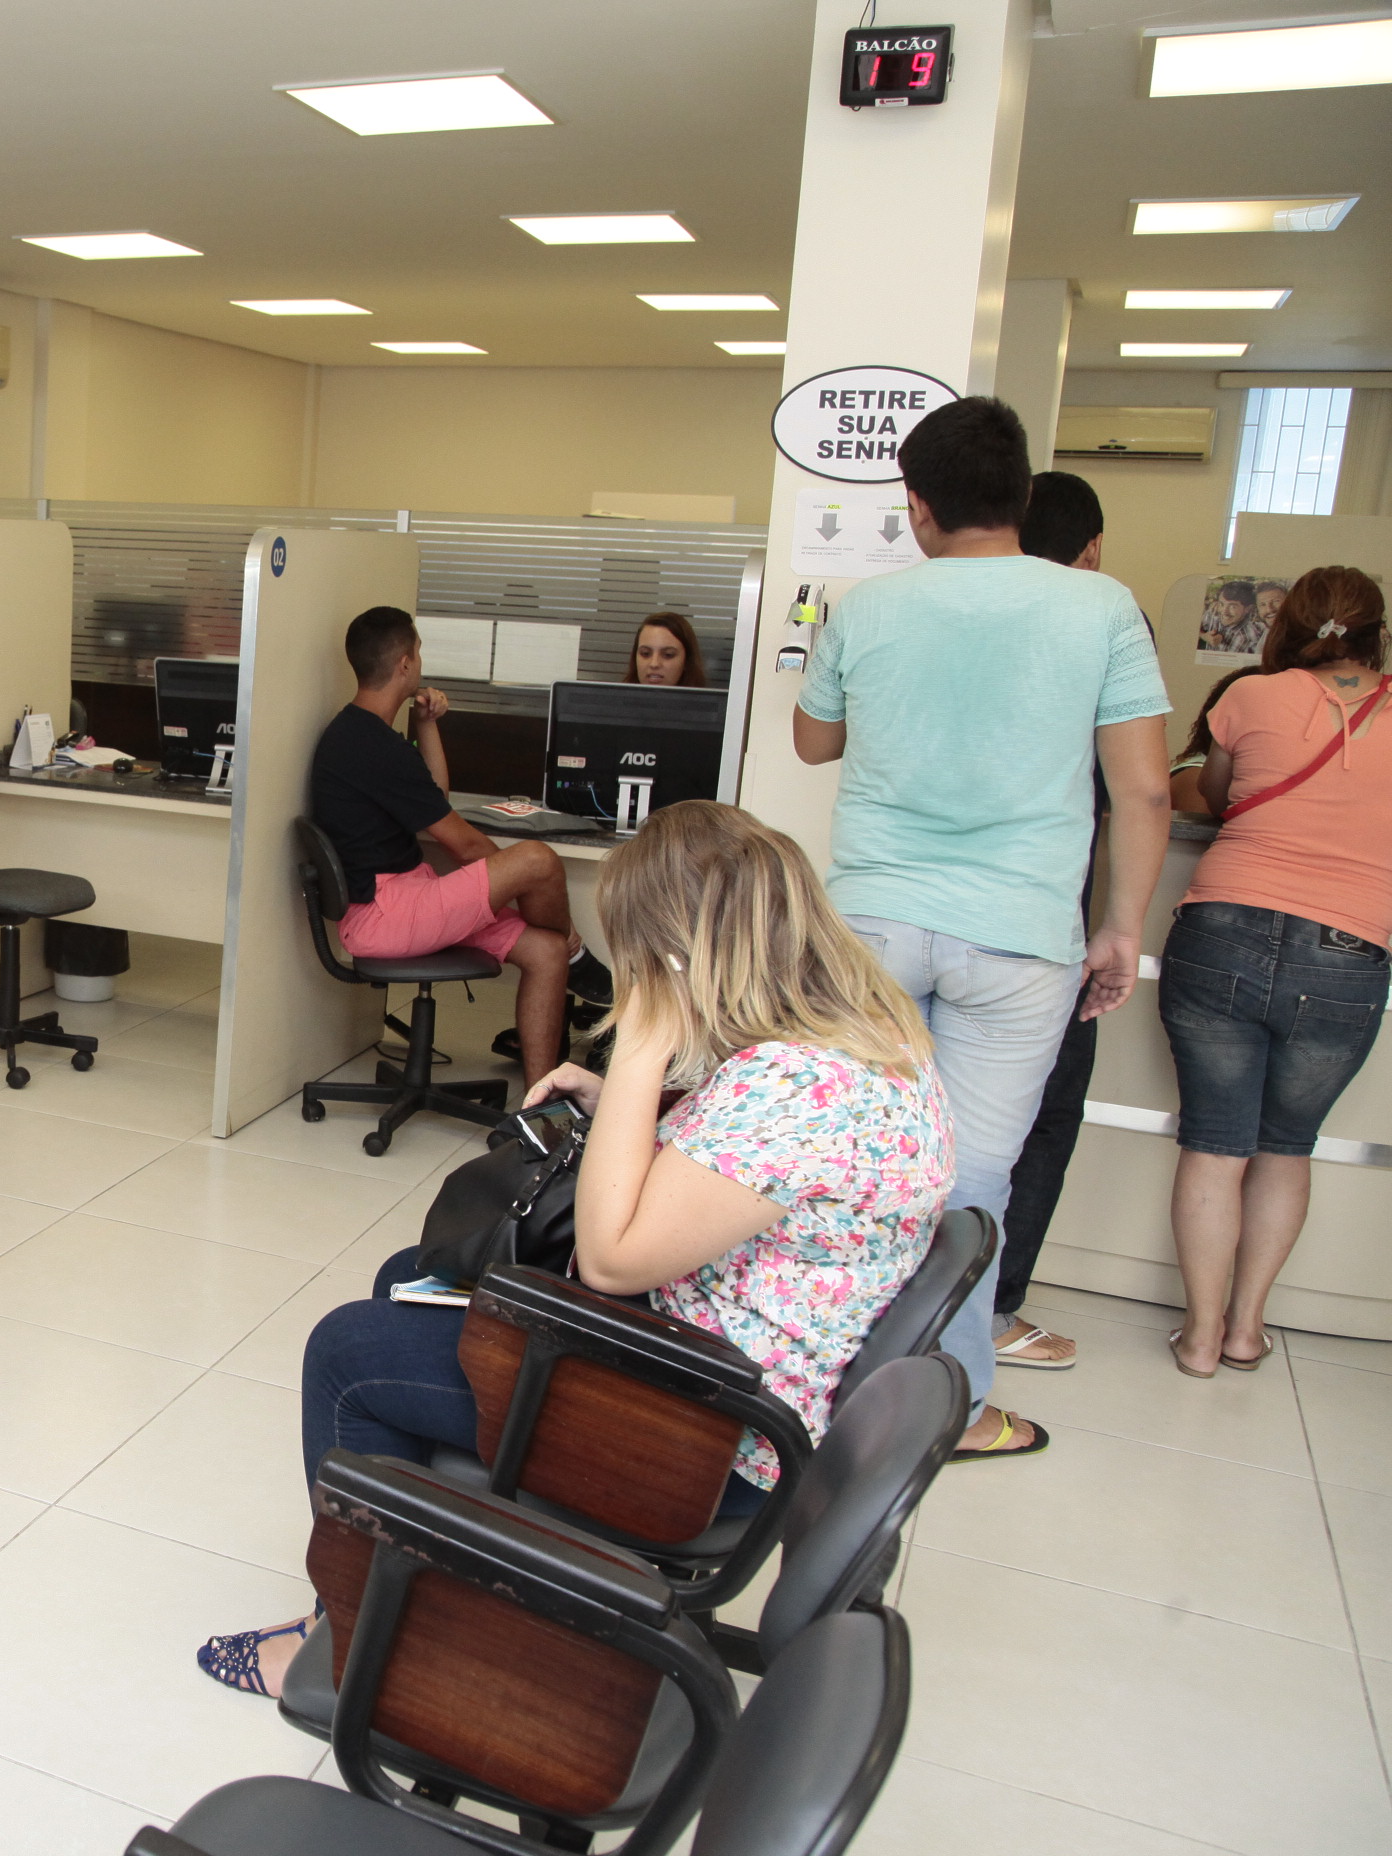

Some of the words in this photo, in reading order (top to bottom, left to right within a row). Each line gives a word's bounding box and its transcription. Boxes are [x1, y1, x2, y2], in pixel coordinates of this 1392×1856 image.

[855, 37, 937, 52] BALCÃO
[818, 389, 927, 410] RETIRE
[837, 415, 898, 435] SUA
[816, 439, 898, 460] SENH
[273, 548, 284, 567] 02
[216, 723, 235, 735] AO
[620, 752, 656, 766] AOC
